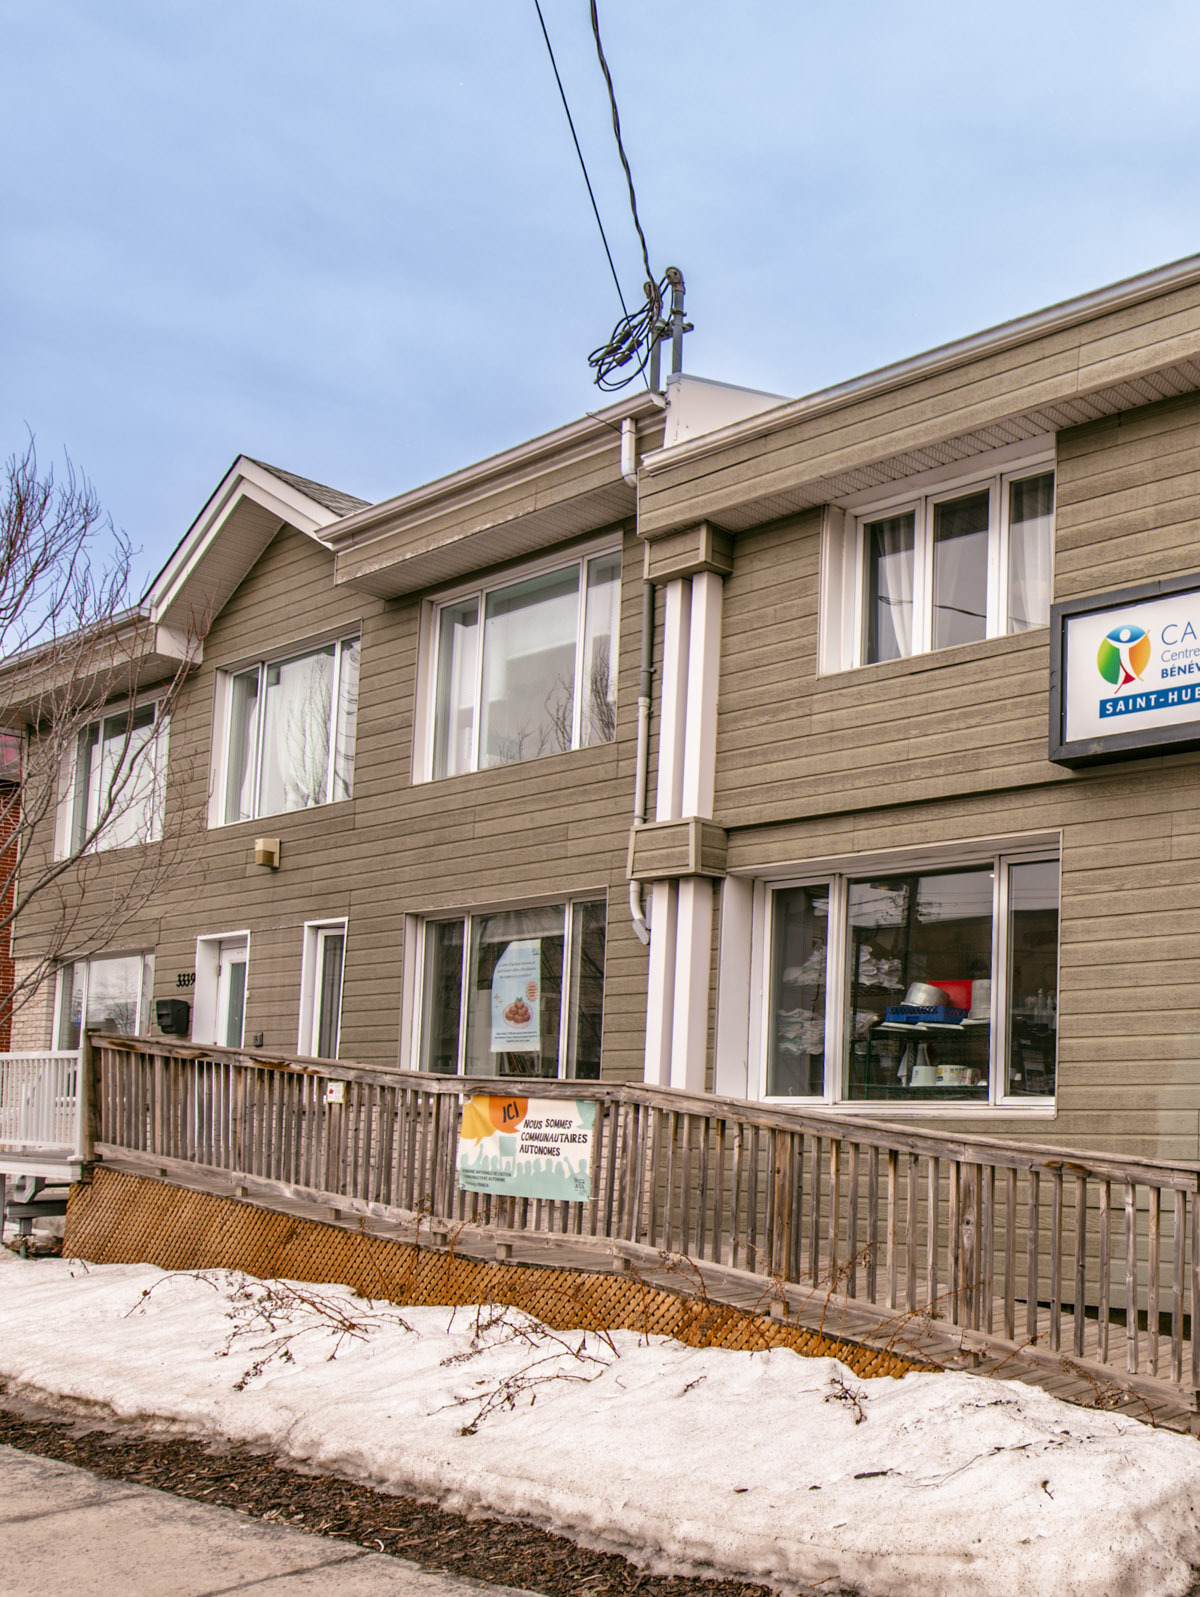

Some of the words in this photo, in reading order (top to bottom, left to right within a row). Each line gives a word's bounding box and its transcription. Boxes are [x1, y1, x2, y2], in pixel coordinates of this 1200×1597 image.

[1161, 647, 1200, 662] Centre
[176, 972, 196, 988] 3339
[502, 1101, 520, 1123] ICI
[523, 1119, 543, 1130] NOUS
[545, 1118, 573, 1129] SOMMES
[520, 1132, 588, 1144] COMMUNAUTAIRES
[519, 1144, 561, 1157] AUTONOMES
